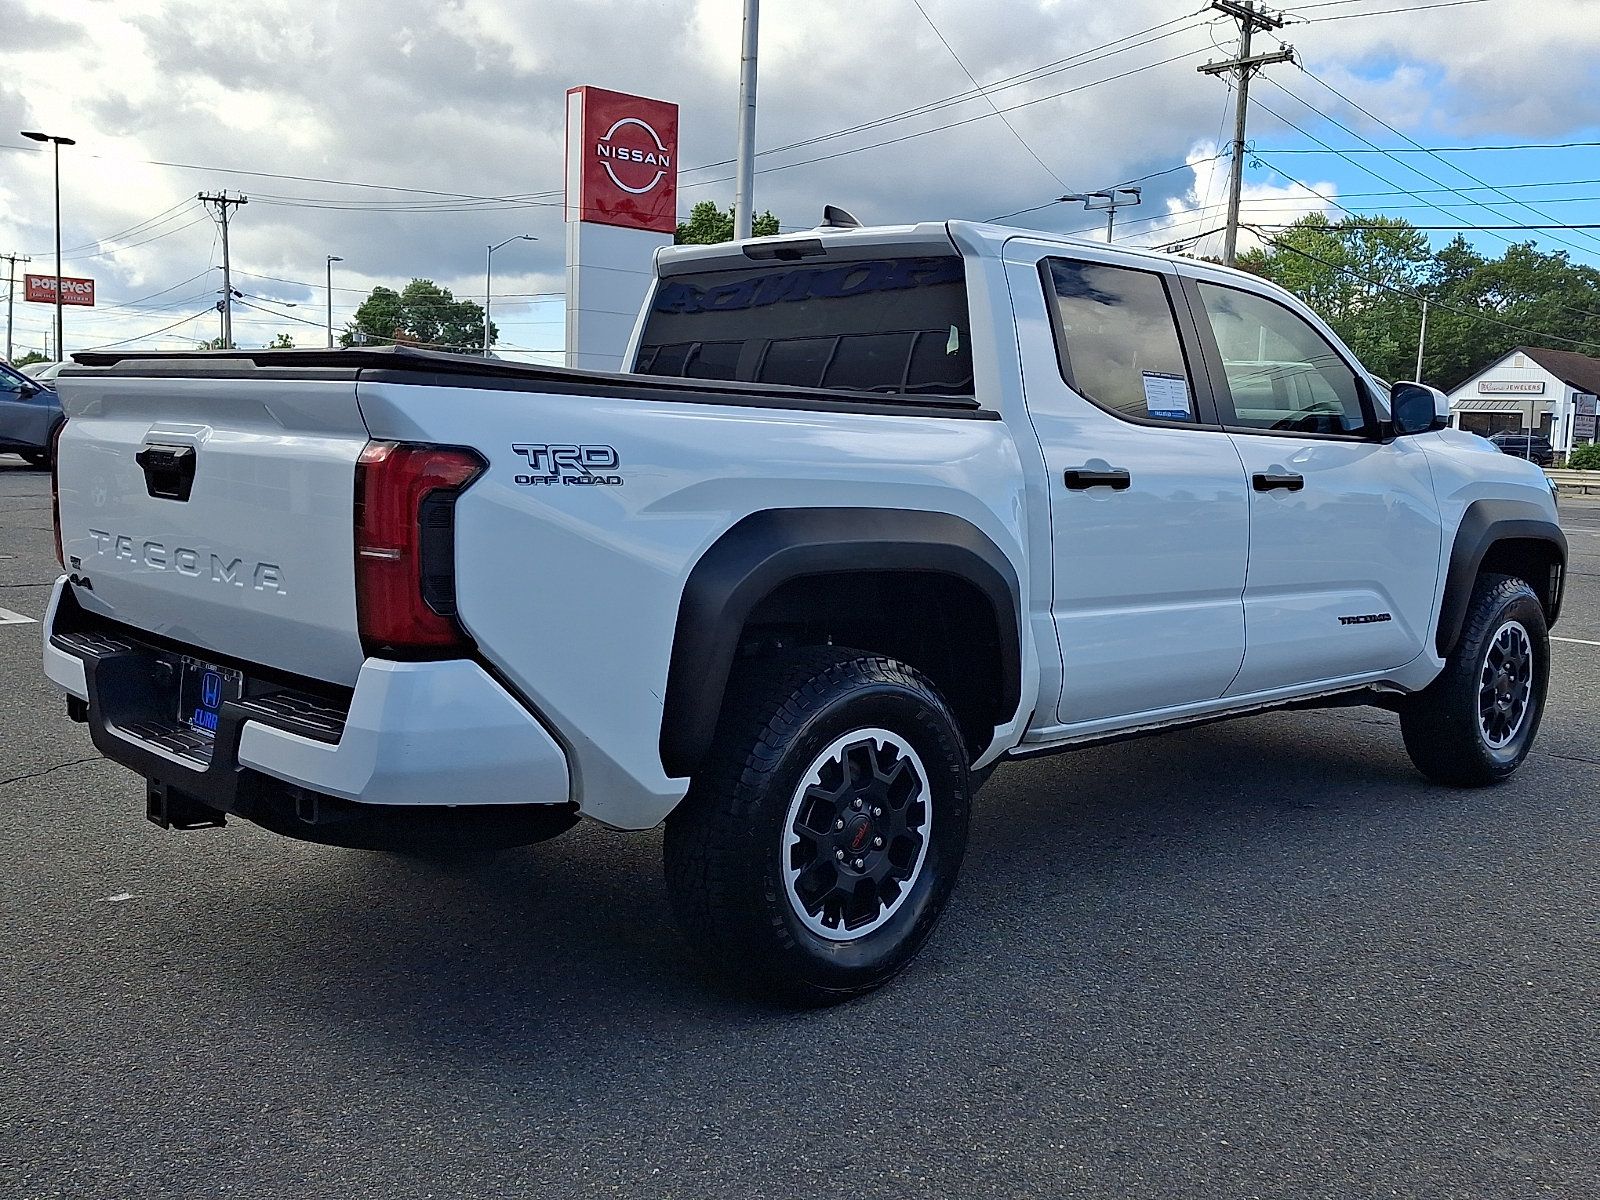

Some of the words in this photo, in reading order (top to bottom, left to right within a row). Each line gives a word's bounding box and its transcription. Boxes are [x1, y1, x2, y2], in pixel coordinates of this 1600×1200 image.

[597, 143, 670, 167] NISSAN
[512, 443, 620, 476] TRD
[514, 475, 560, 486] OFF
[562, 475, 624, 486] ROAD
[89, 528, 287, 595] TACOMA
[1337, 612, 1392, 626] TACOMA
[194, 708, 218, 730] CURR
